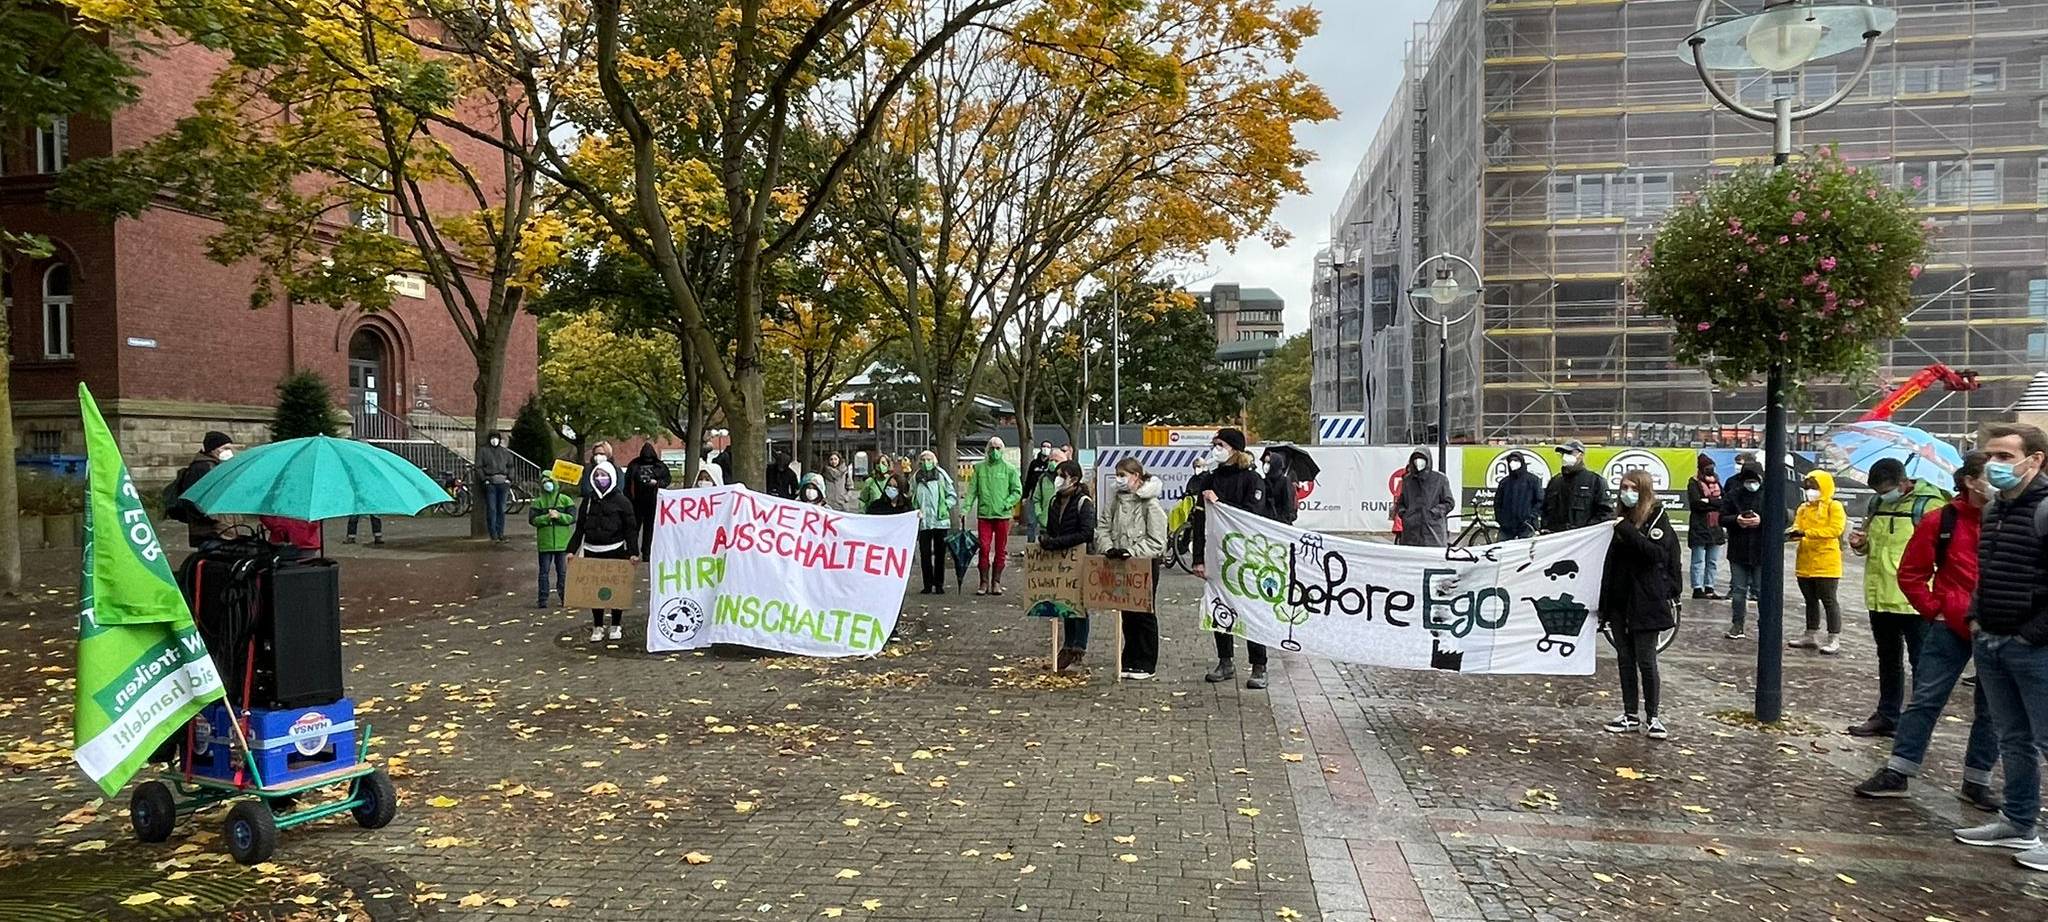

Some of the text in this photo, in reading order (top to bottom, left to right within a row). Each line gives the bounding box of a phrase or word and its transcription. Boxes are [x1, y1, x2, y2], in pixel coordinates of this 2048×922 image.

[1159, 472, 1191, 482] CHÜT
[660, 491, 842, 537] KRAFTWERK
[1297, 501, 1341, 511] OLZ.com
[712, 523, 907, 579] AUSSCHALTEN
[1288, 543, 1415, 627] before
[1422, 568, 1511, 638] Ego
